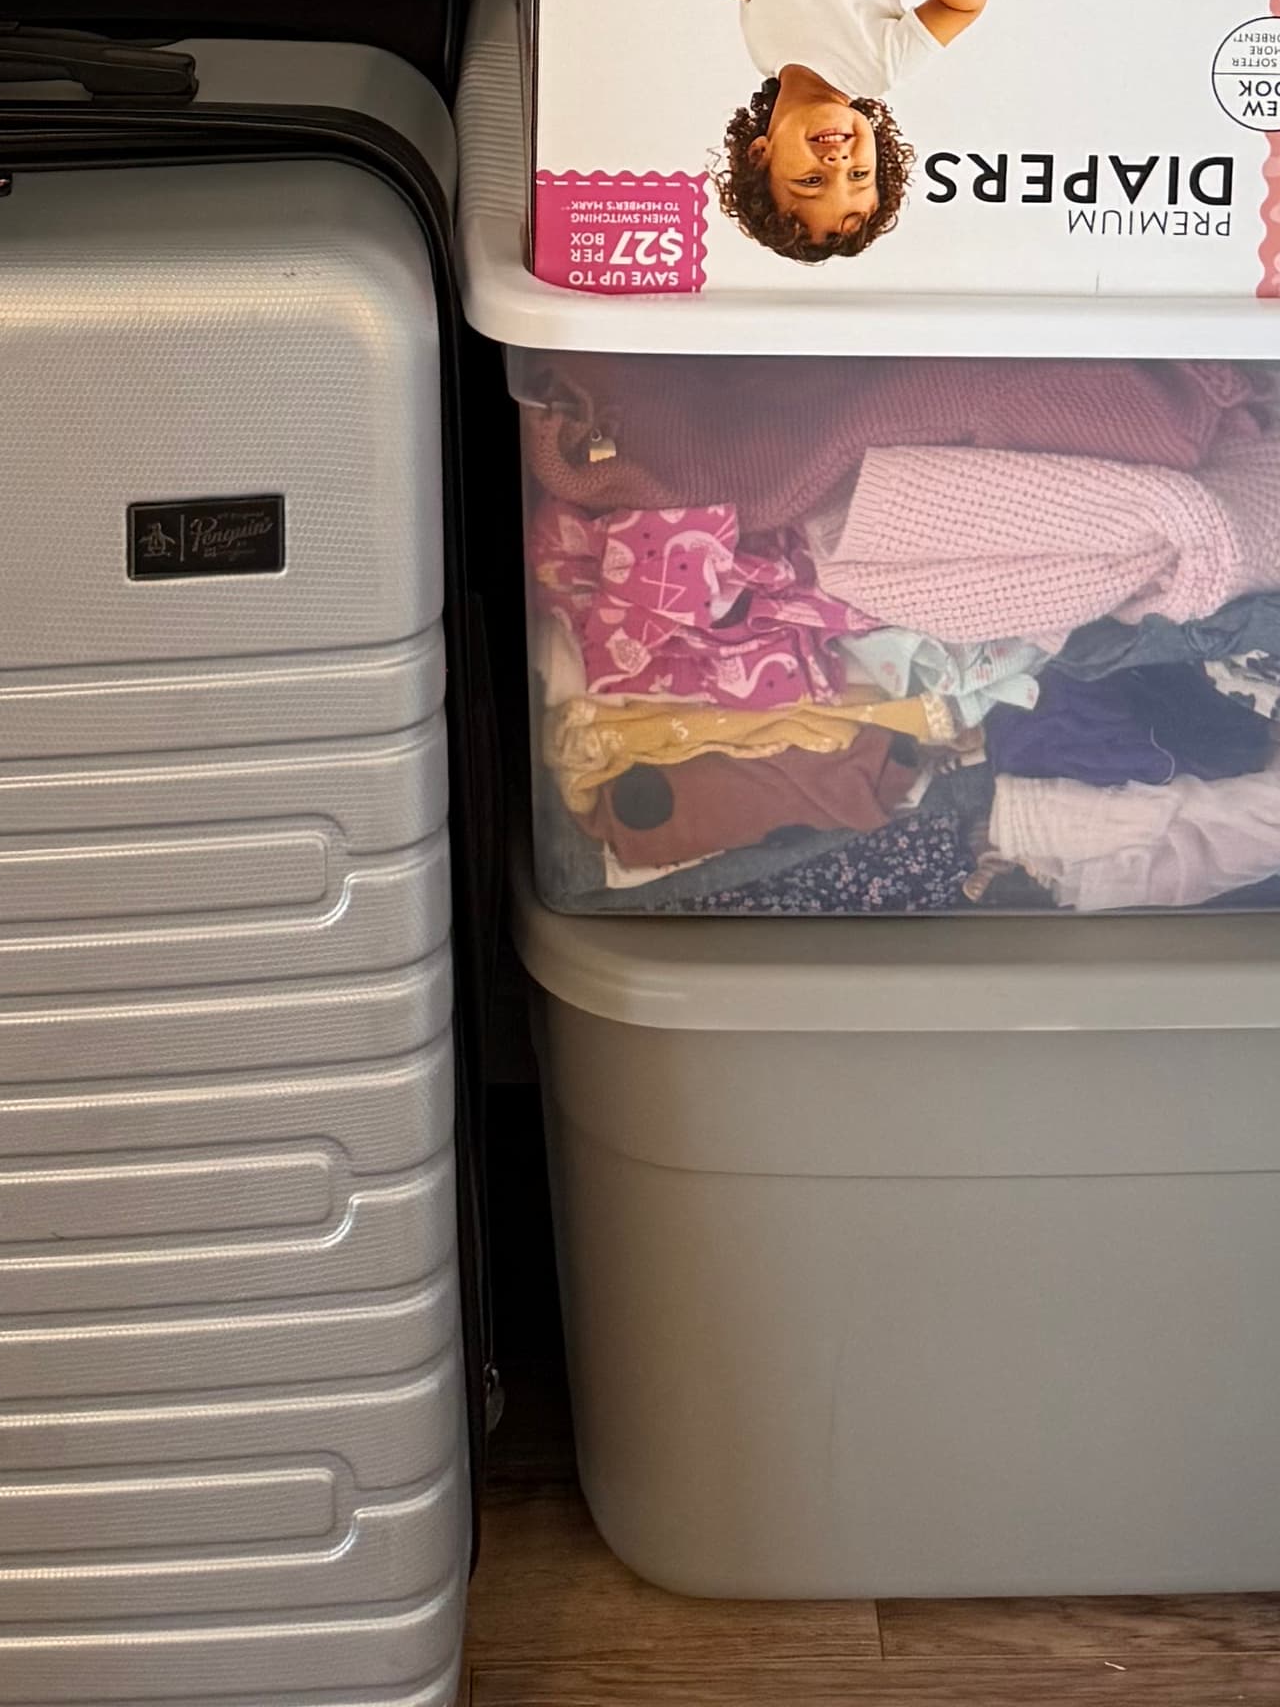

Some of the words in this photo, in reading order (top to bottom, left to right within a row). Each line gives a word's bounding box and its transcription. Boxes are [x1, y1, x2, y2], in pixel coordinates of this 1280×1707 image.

[1231, 56, 1278, 68] SOFTER
[924, 152, 1234, 206] DIAPERS
[606, 200, 662, 212] MEMBER'S
[664, 201, 680, 211] TO
[570, 212, 641, 224] SWITCHING
[642, 213, 681, 224] WHEN
[1067, 210, 1231, 237] PREMIUM
[570, 232, 605, 245] BOX
[608, 227, 684, 267] $27
[570, 248, 604, 263] PER
[568, 270, 597, 285] TO
[599, 270, 626, 285] UP
[631, 271, 679, 286] SAVE
